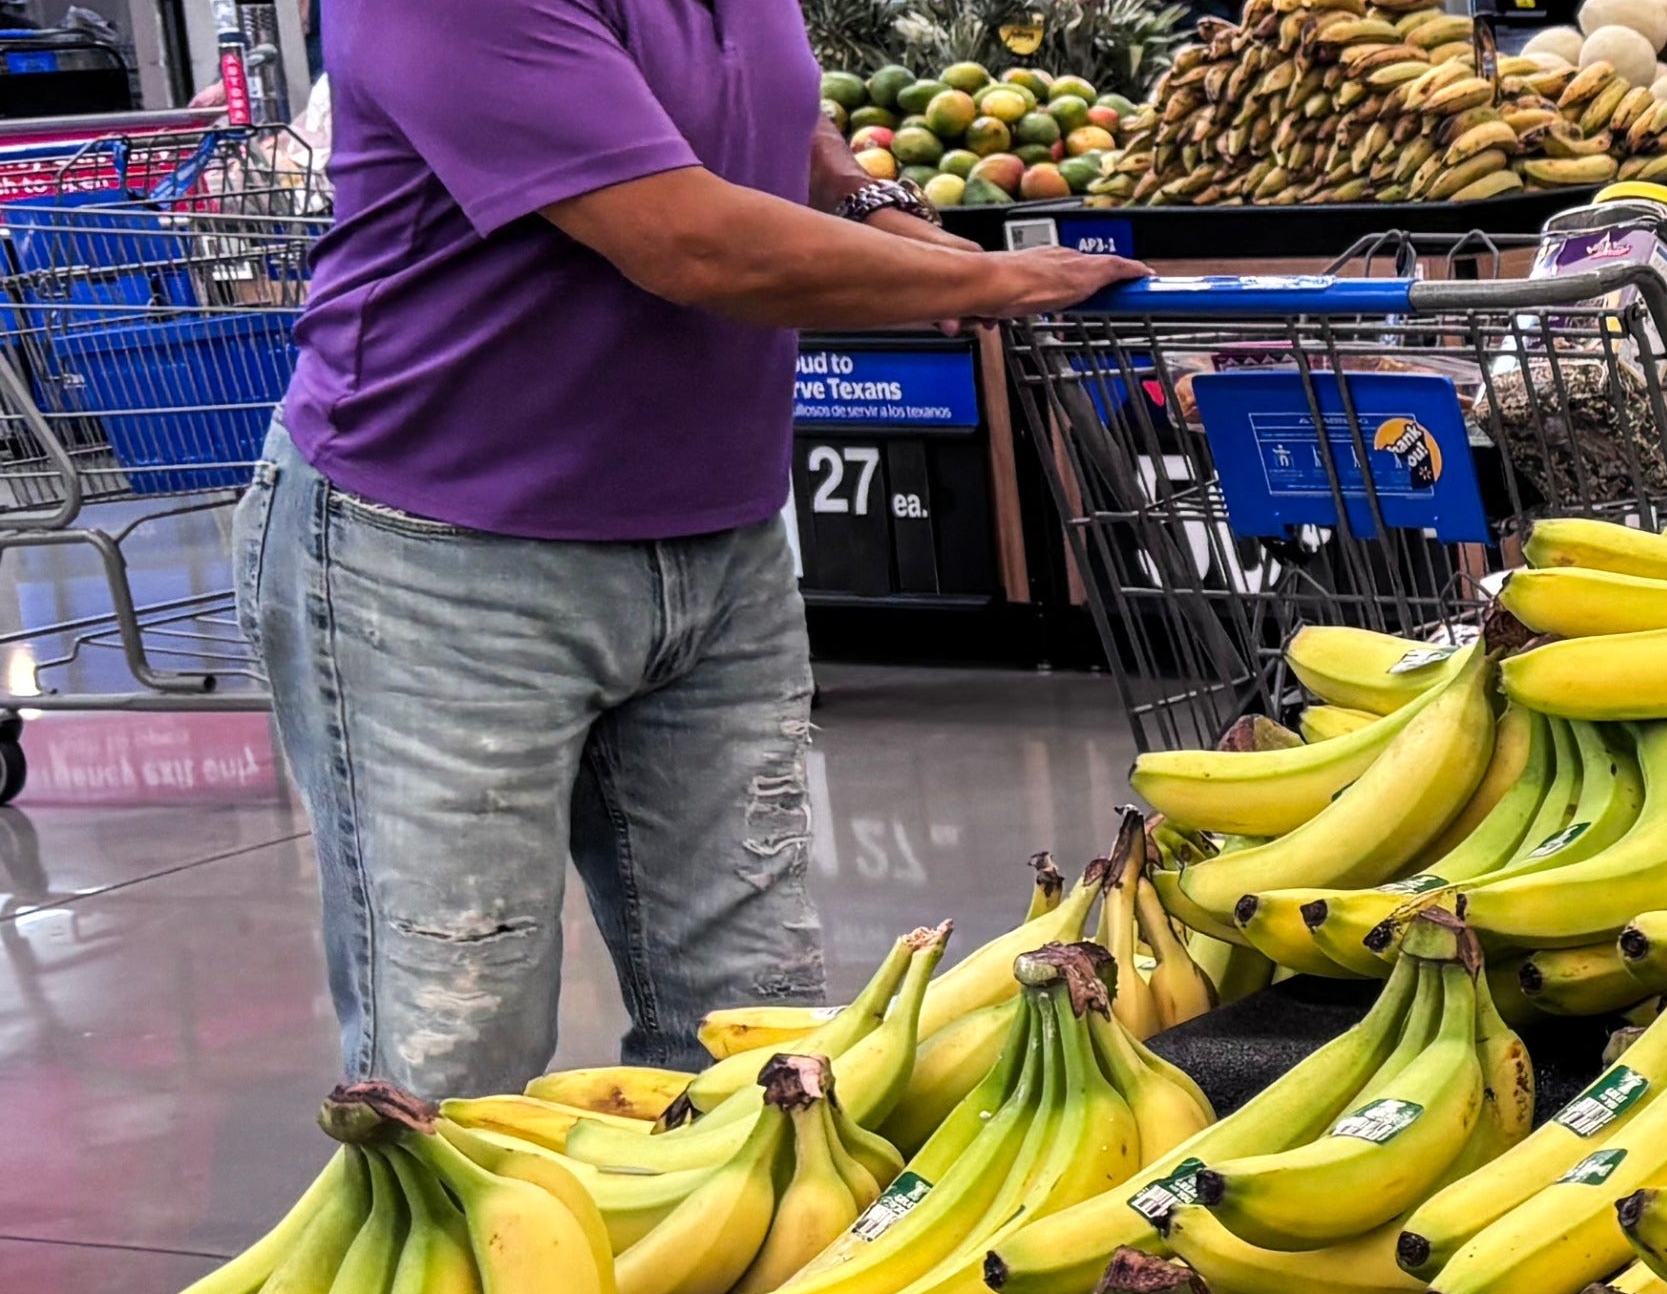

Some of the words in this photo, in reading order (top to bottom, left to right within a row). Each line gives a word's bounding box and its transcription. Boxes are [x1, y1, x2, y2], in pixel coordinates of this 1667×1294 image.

[831, 353, 853, 374] to
[828, 378, 902, 401] Texans
[907, 405, 952, 419] texanos
[808, 446, 880, 515] 27
[893, 492, 928, 518] ea.
